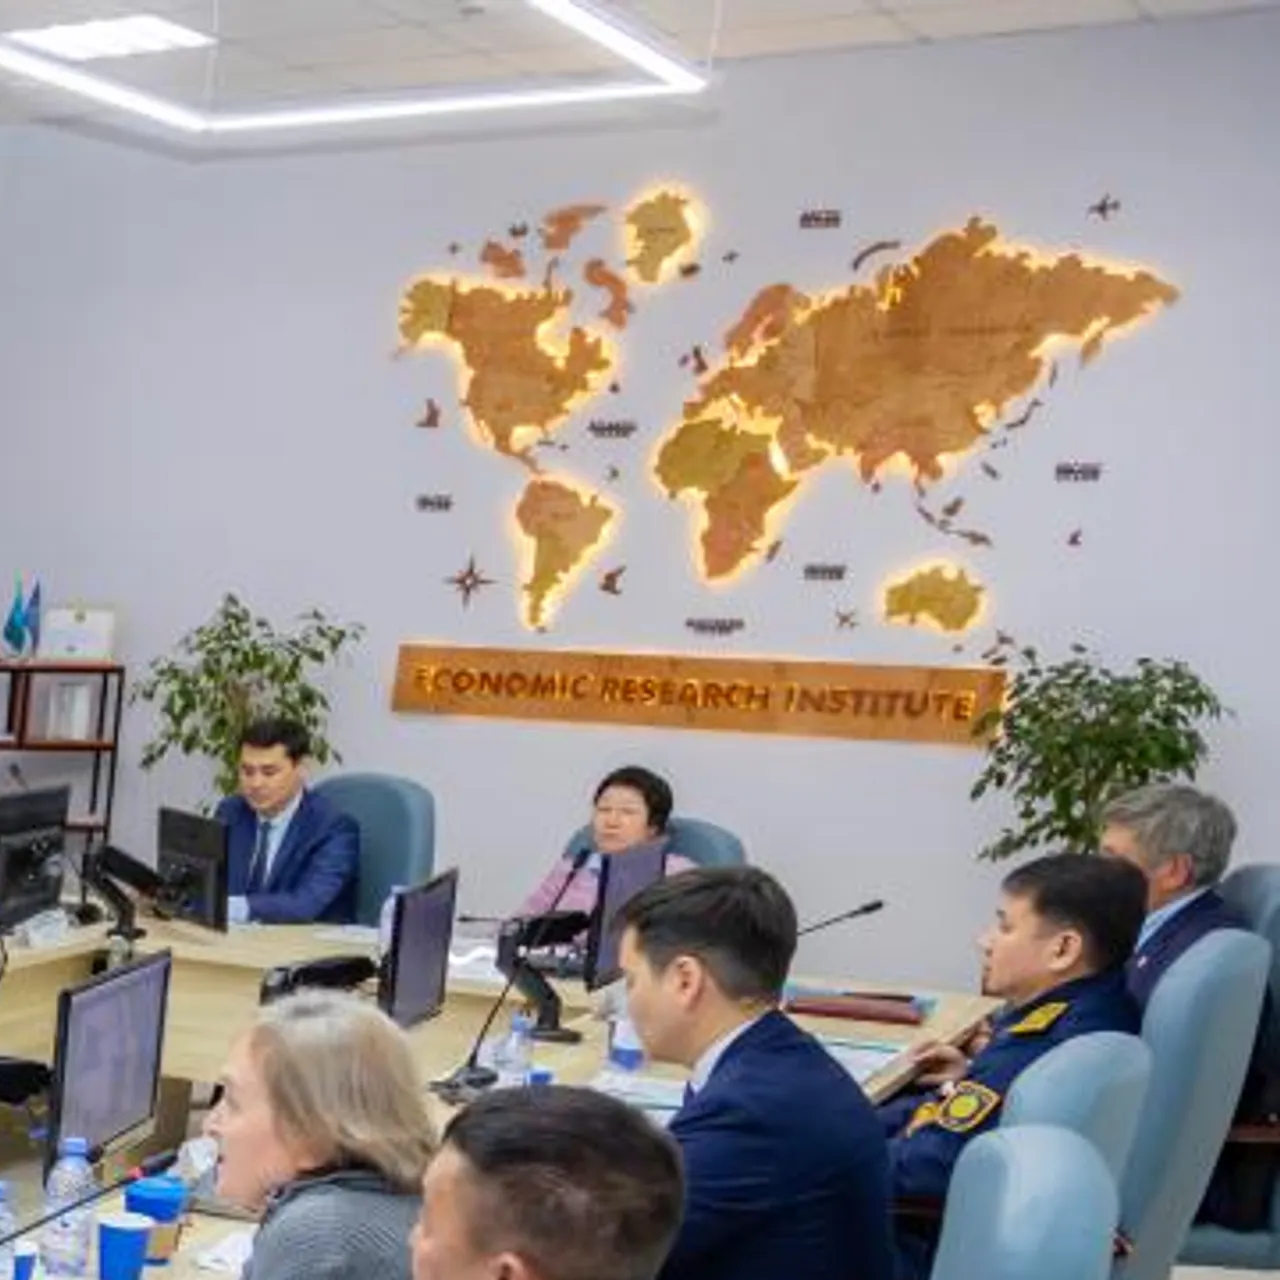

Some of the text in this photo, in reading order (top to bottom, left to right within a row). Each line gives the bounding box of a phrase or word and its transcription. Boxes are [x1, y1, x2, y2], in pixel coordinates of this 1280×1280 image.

[413, 666, 976, 721] ECONOMIC RESEARCH INSTITUTE
